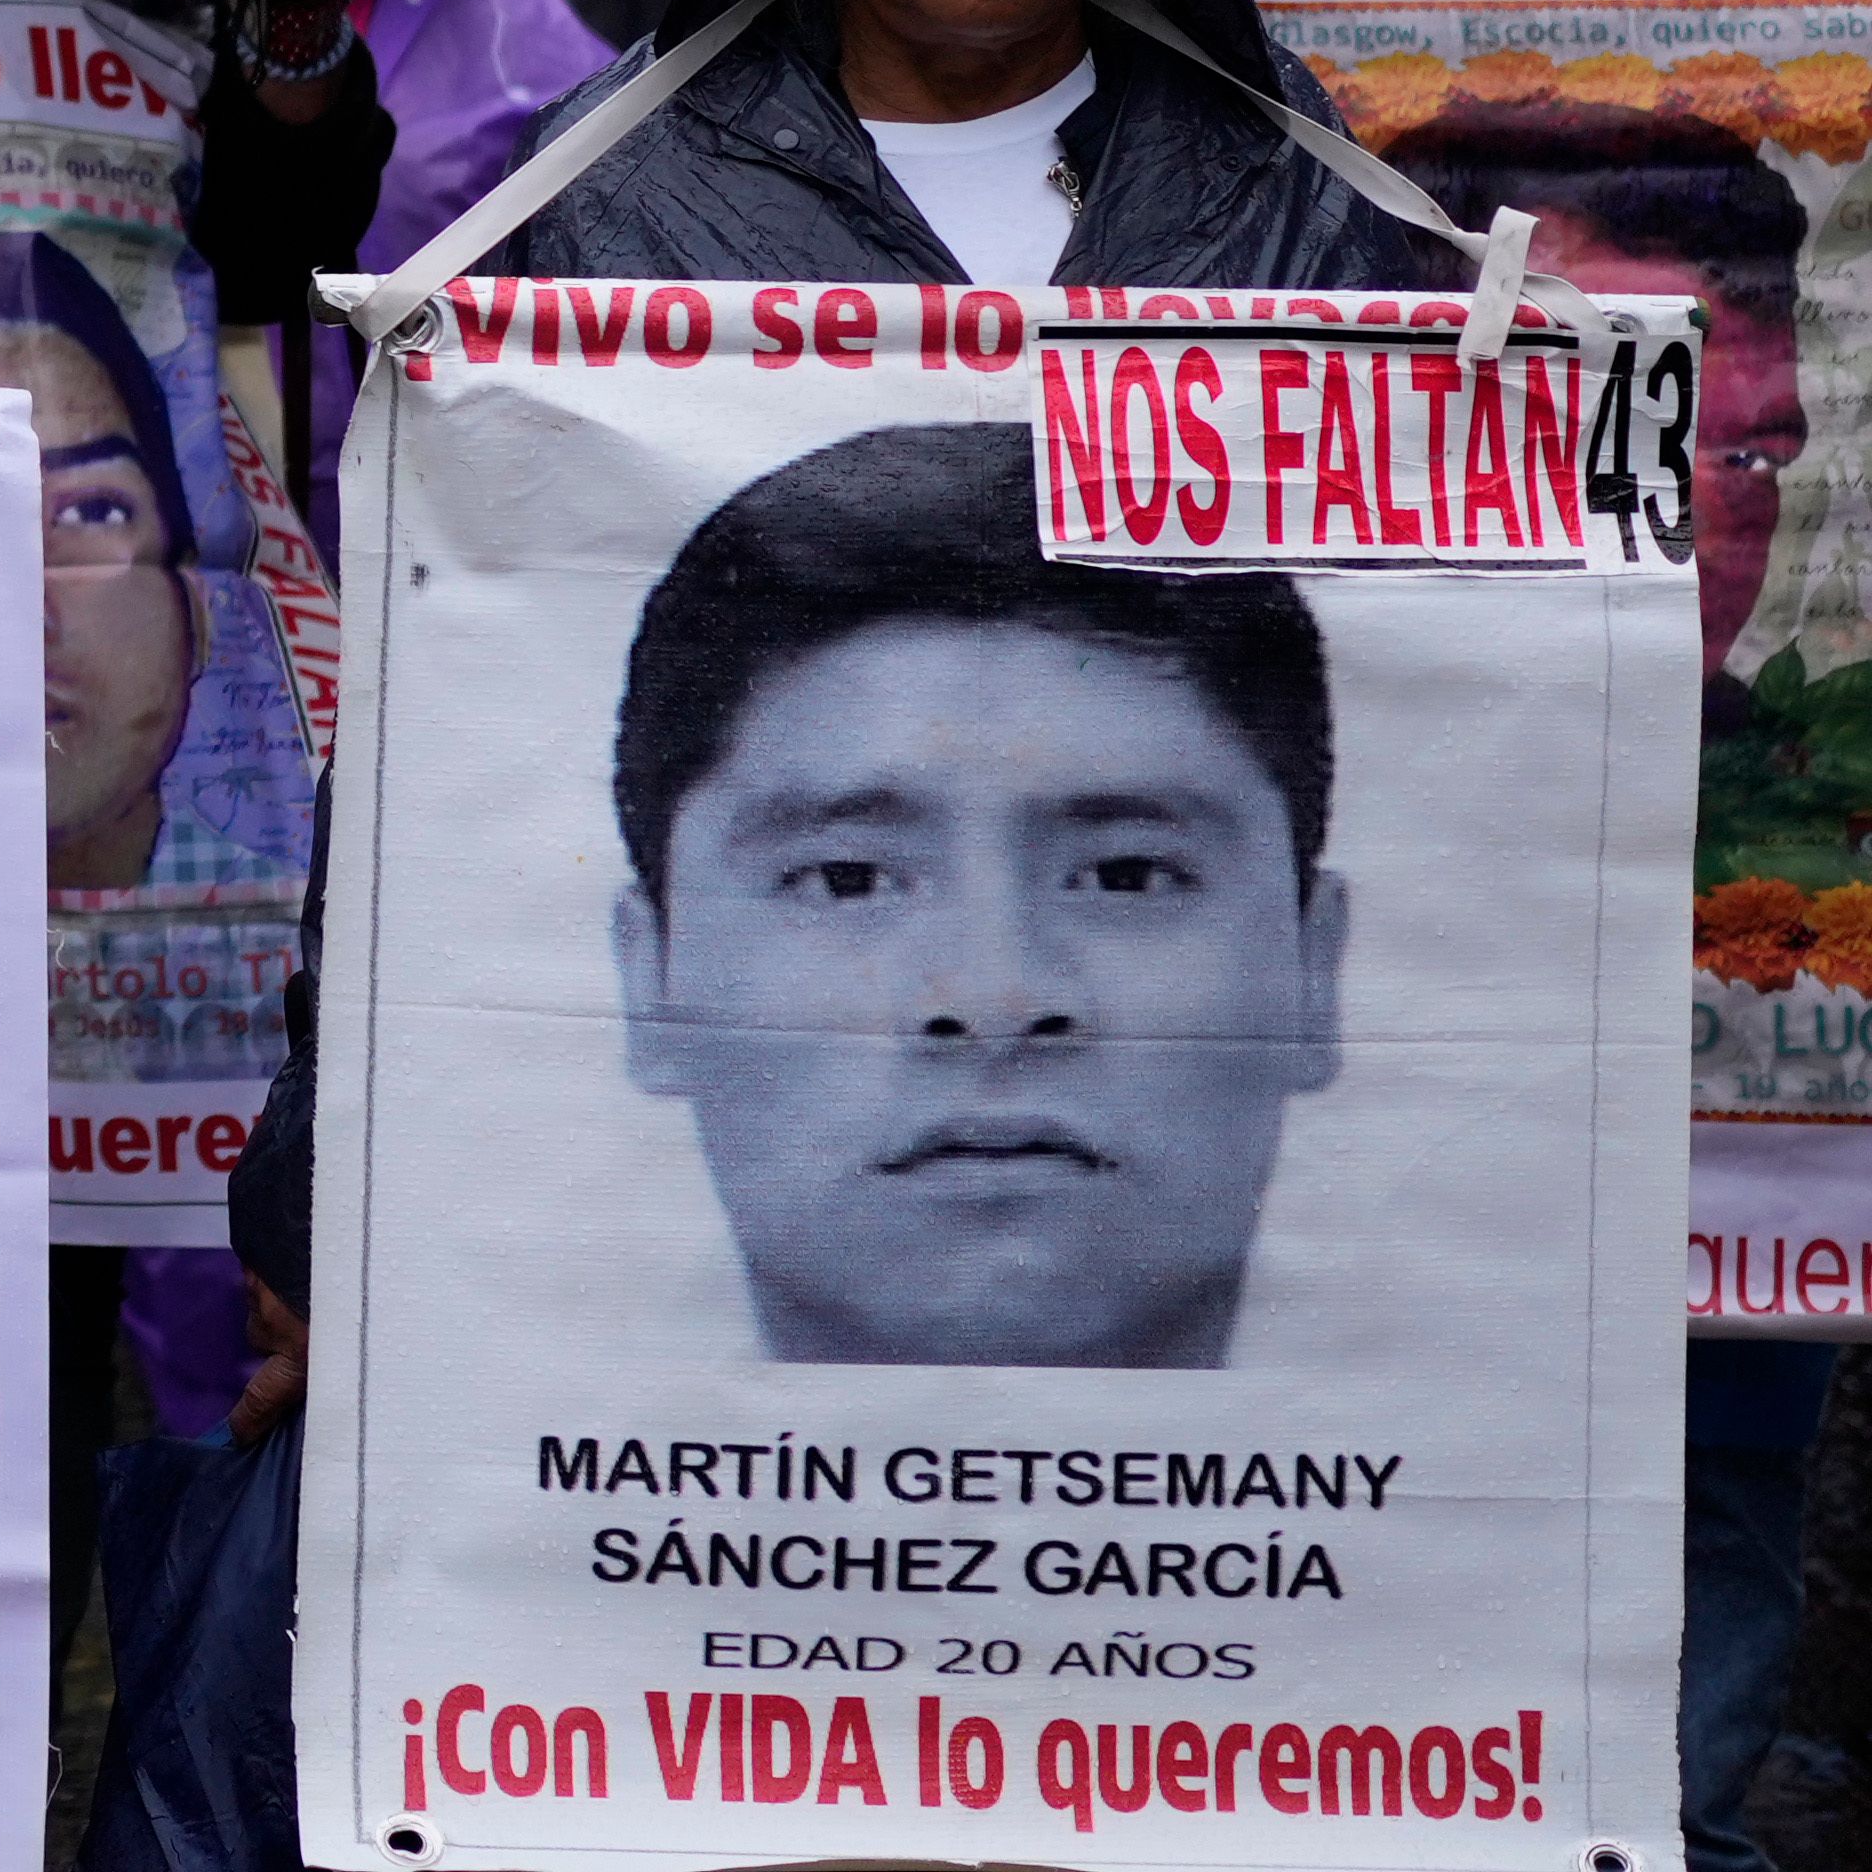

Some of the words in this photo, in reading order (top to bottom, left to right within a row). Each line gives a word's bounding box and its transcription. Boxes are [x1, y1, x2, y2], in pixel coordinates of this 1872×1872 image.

[1461, 13, 1629, 49] Escocia,
[1651, 14, 1780, 50] quiero
[752, 287, 878, 370] se
[921, 284, 1024, 372] lo
[1041, 346, 1233, 548] NOS
[1258, 349, 1585, 550] FALTAN
[537, 1433, 856, 1503] MARTÍN
[883, 1447, 1403, 1510] GETSEMANY
[591, 1518, 999, 1594] SÁNCHEZ
[1024, 1531, 1344, 1601] GARCÍA
[702, 1632, 907, 1673] EDAD
[935, 1637, 1021, 1676] 20
[1050, 1632, 1257, 1680] AÑOS
[402, 1684, 609, 1811] ¡Con
[644, 1691, 888, 1806] VIDA
[919, 1695, 1005, 1809] lo
[1038, 1710, 1544, 1834] queremos!
